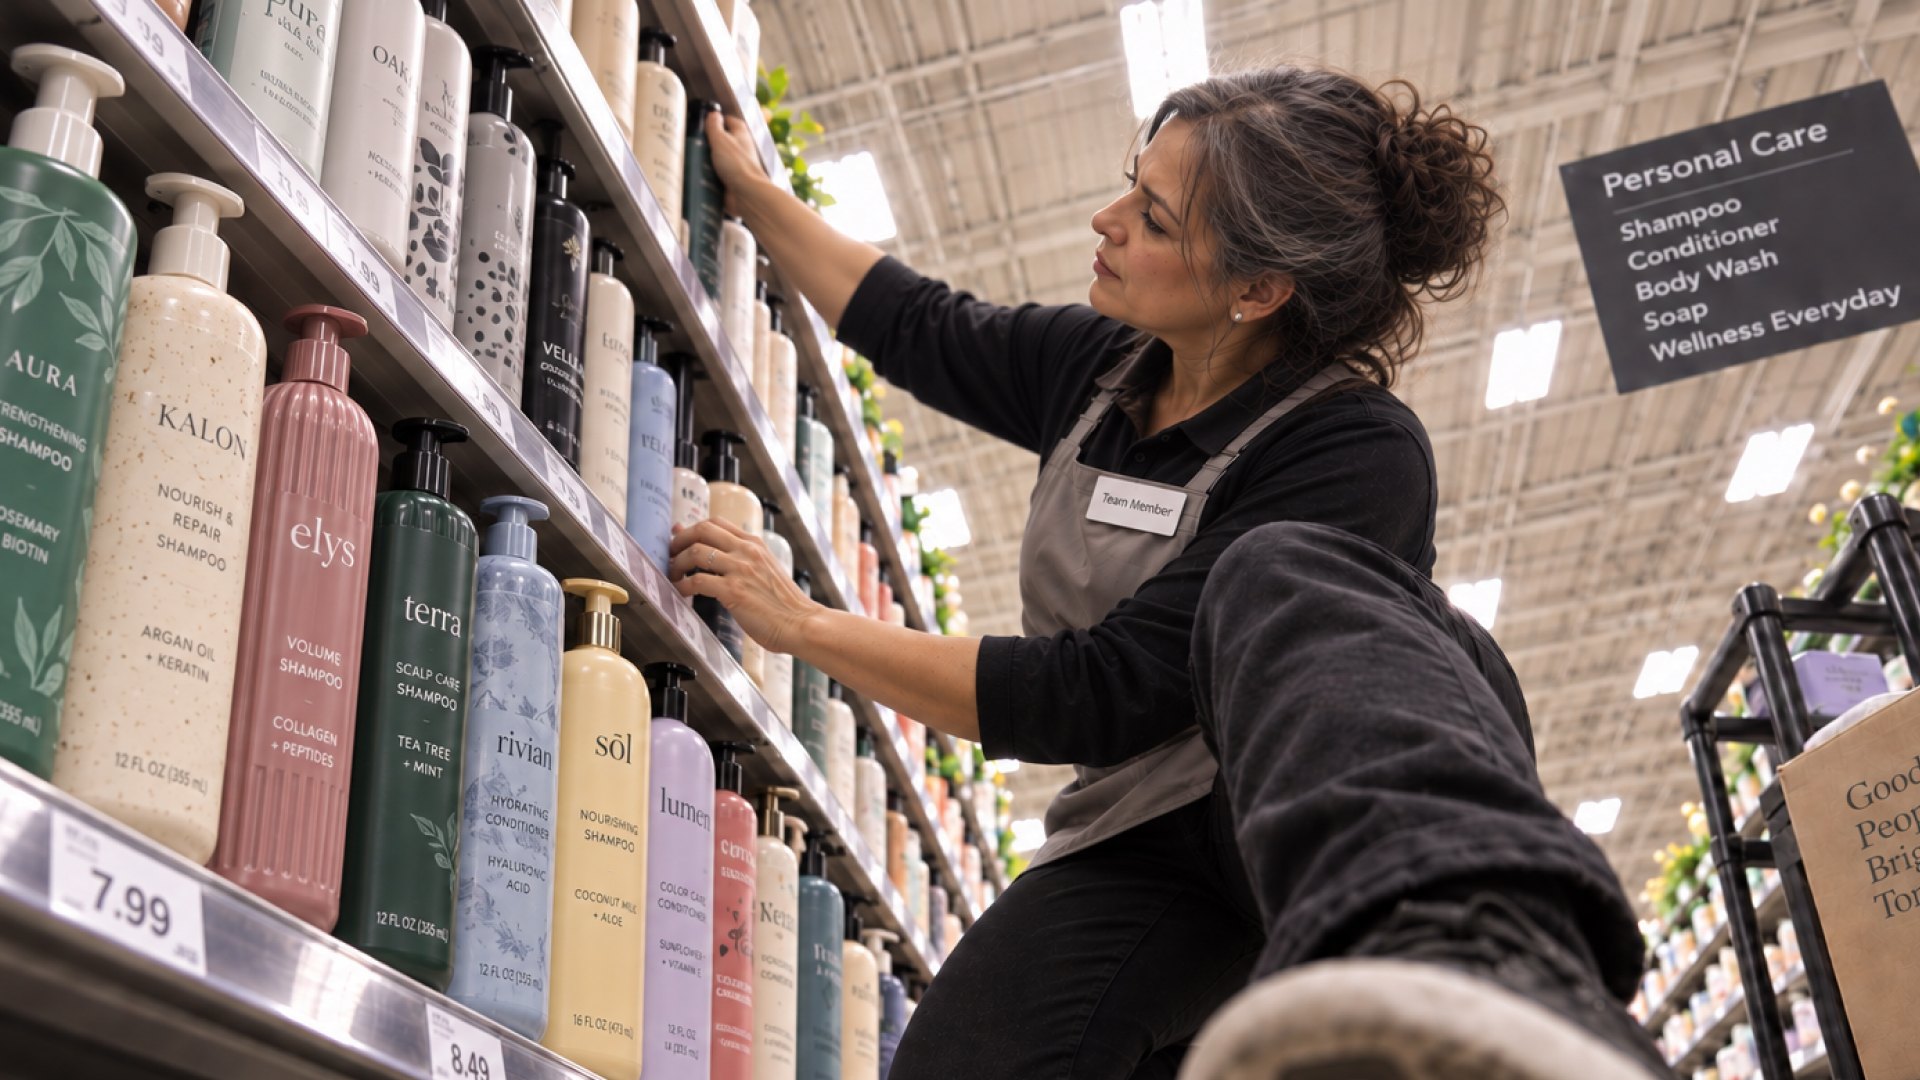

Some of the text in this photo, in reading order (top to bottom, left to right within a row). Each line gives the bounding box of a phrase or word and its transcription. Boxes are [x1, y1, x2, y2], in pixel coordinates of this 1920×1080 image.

[1602, 122, 1828, 198] Personal Care
[1619, 197, 1742, 242] Shampoo
[1627, 217, 1780, 272] Conditioner
[1635, 248, 1779, 302] Body Wash
[1643, 301, 1708, 332] Soap
[1649, 285, 1901, 363] Wellness Everyday
[5, 350, 77, 397] AURA
[0, 400, 87, 454] RENGTHENING
[157, 404, 248, 461] KALON
[157, 483, 234, 528] NOURISH &
[1103, 492, 1174, 518] Team Member
[173, 513, 222, 544] REPAIR
[289, 517, 356, 569] elys
[2, 532, 49, 565] BIOTIN
[157, 534, 227, 572] SHAMPOO
[404, 595, 462, 638] terra
[140, 624, 216, 664] ARGAN OIL
[286, 636, 342, 668] VOLUME
[157, 653, 210, 684] KERATIN
[279, 658, 344, 691] SHAMPOO
[396, 661, 461, 693] SCALP CARE
[396, 683, 458, 712] SHAMPOO
[273, 715, 338, 747] COLLAGEN
[271, 742, 335, 769] + PEPTIDES
[397, 735, 451, 762] TEA TREE
[496, 731, 552, 771] rivian
[115, 752, 128, 769] 12
[131, 756, 145, 774] FL
[148, 760, 167, 778] OZ
[402, 760, 444, 780] + MINT
[491, 795, 550, 822] HYDRATING
[659, 786, 711, 832] lumen
[583, 829, 636, 854] SHAMPOO
[506, 879, 531, 895] ACID
[574, 888, 621, 908] COCONUT
[659, 881, 689, 897] COLOR
[90, 868, 171, 939] 7.99
[601, 911, 624, 927] ALOE
[376, 911, 387, 926] 12
[388, 913, 401, 928] FL
[402, 916, 416, 931] OZ
[479, 963, 489, 976] 12
[490, 964, 501, 979] FL
[572, 1013, 584, 1027] 16
[584, 1015, 595, 1029] FL
[594, 1018, 608, 1032] OZ
[450, 1043, 492, 1080] 8.49
